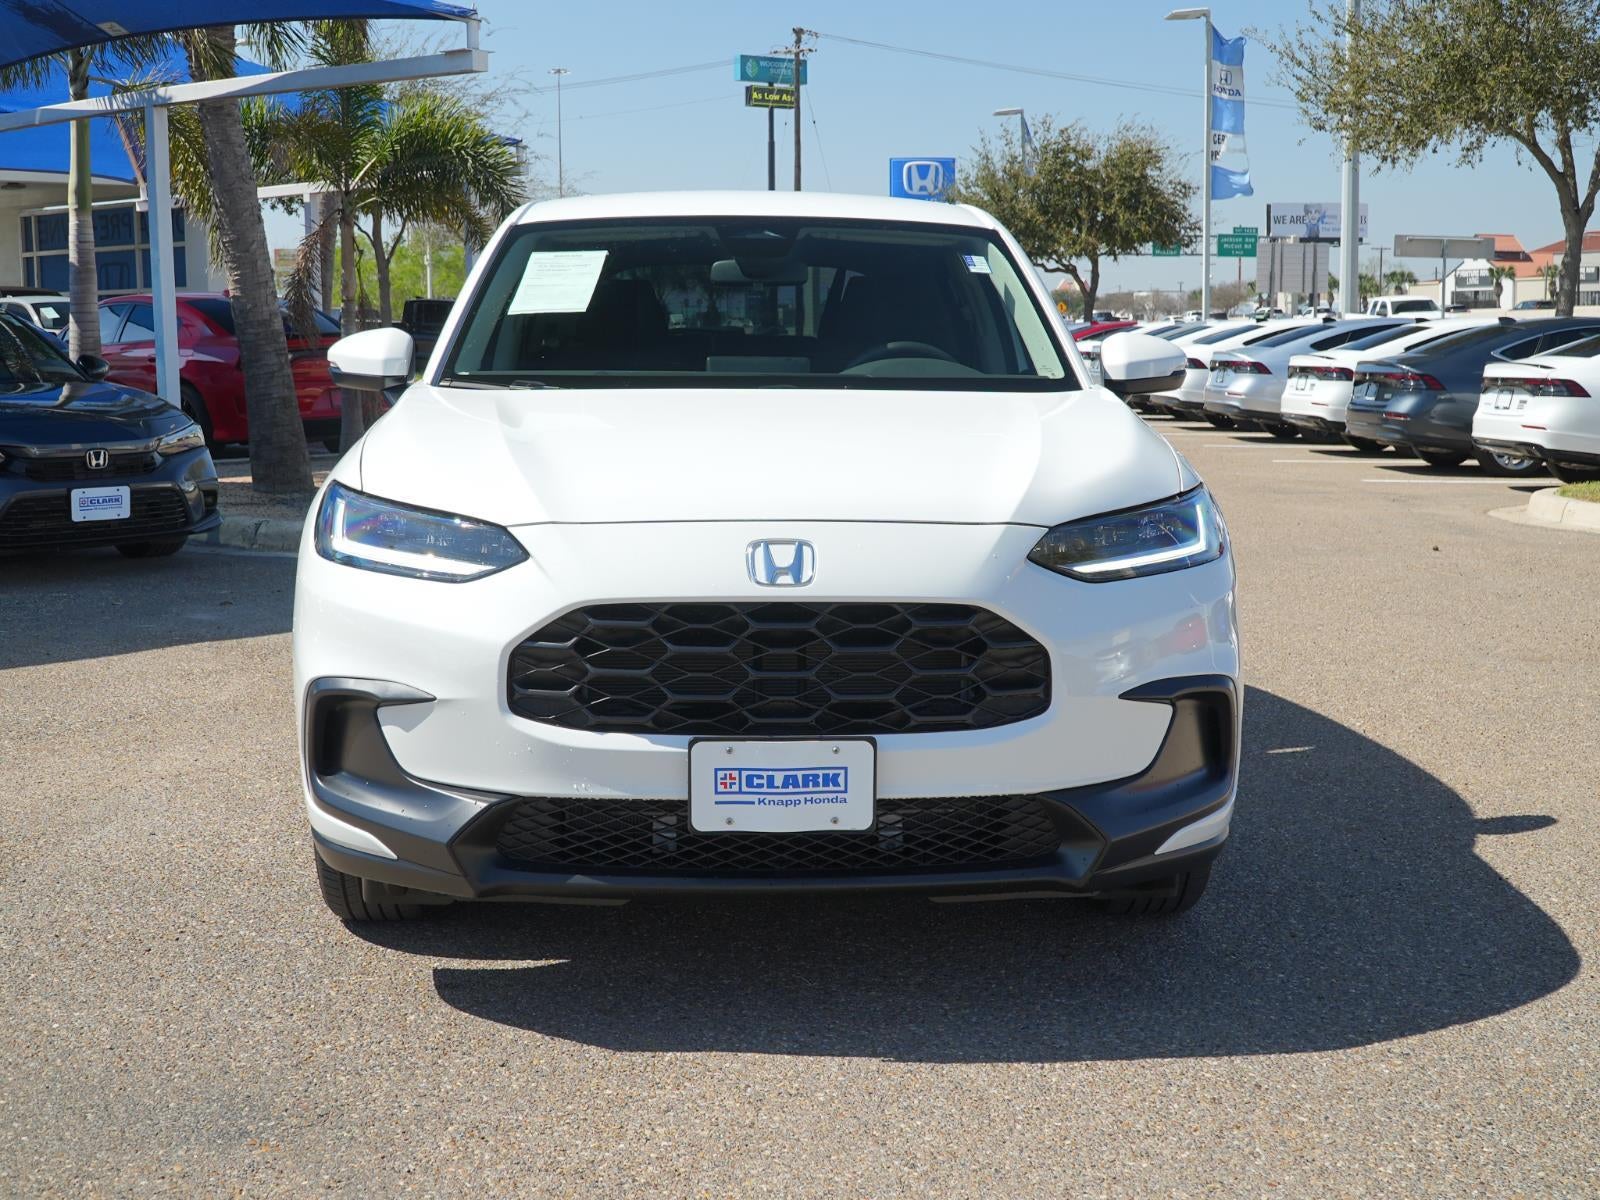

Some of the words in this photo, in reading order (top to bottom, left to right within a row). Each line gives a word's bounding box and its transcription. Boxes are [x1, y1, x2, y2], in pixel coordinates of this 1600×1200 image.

[1213, 83, 1241, 97] HONDA
[1273, 215, 1287, 225] WE
[1289, 215, 1307, 225] ARE
[746, 773, 841, 789] CLARK
[757, 798, 801, 807] Knapp
[804, 796, 847, 804] Honda
